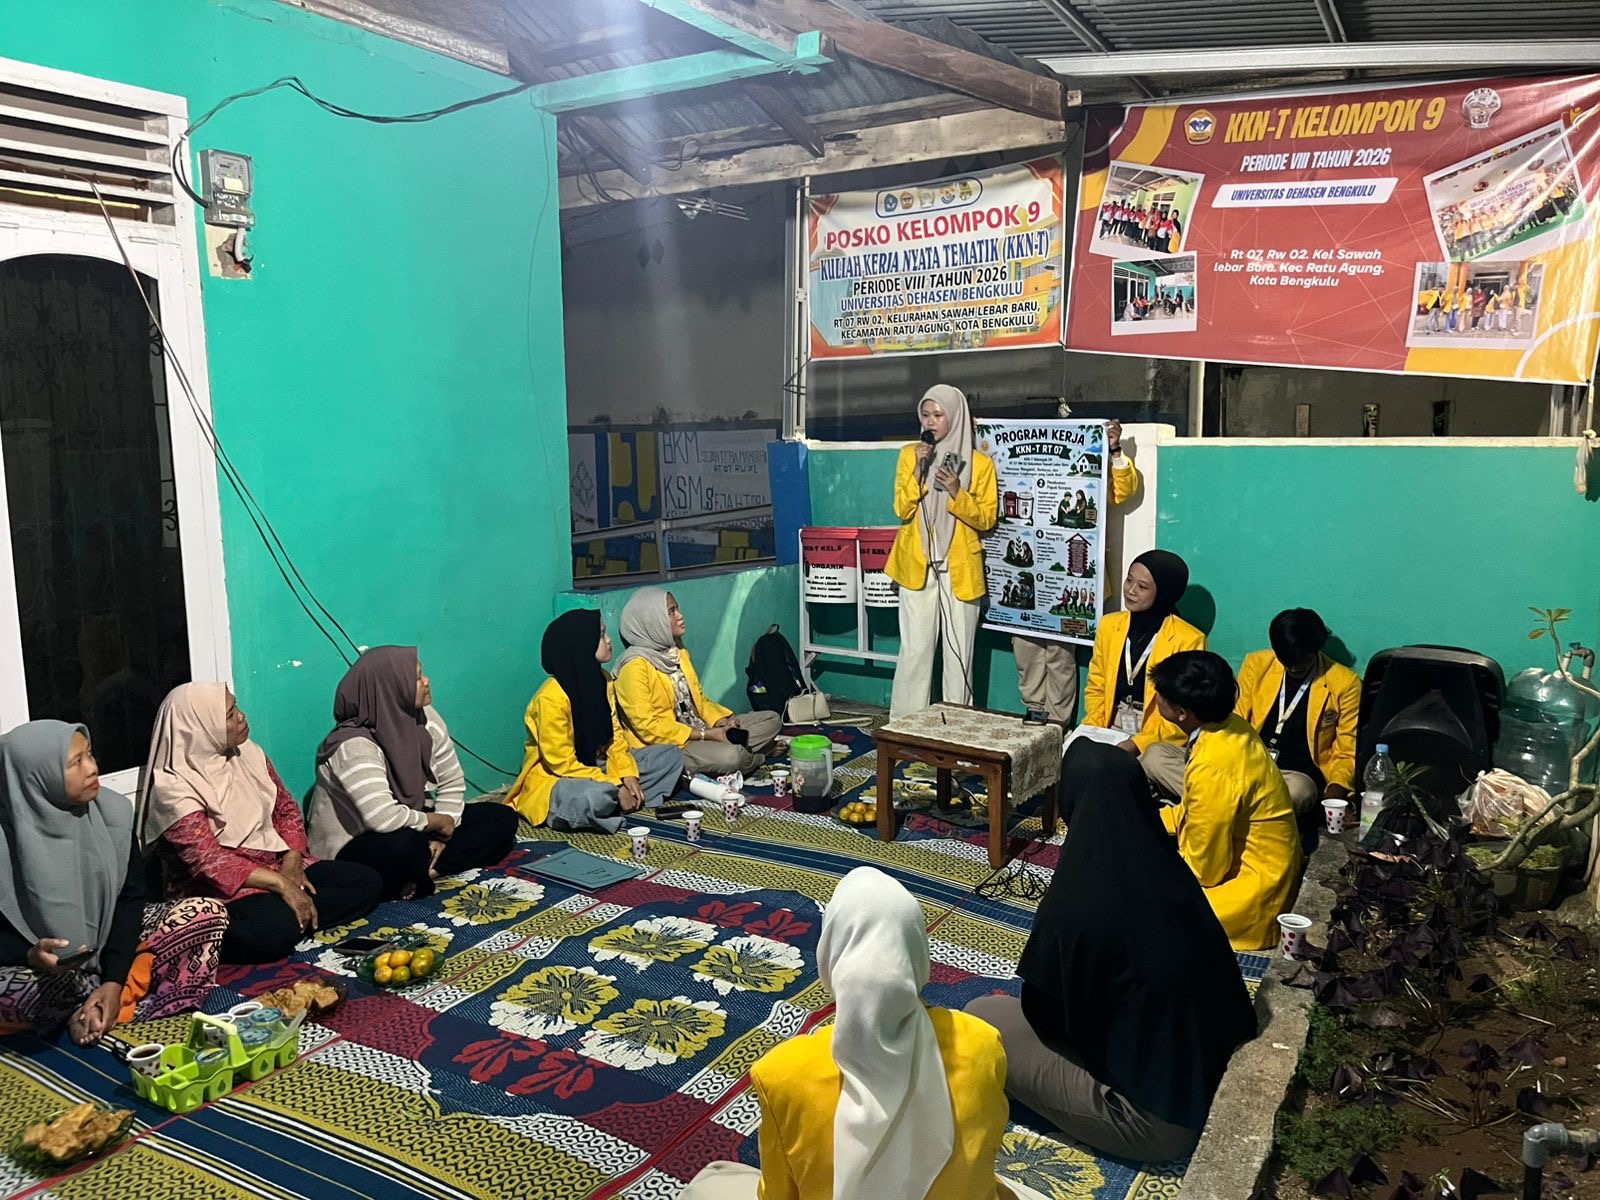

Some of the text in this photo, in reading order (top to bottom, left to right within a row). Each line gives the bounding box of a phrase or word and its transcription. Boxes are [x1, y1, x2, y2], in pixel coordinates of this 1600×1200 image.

[1224, 96, 1447, 144] KKN-T KELOMPOK 9
[1239, 147, 1393, 173] PERIODE VIII TAHUN 2026
[1231, 185, 1376, 201] UNIVERSITAS DEHASEN BENGKULU
[826, 201, 1041, 250] POSKO KELOMPOK 9
[820, 230, 1049, 281] KULIAH KERJA NYATA TEMATIK (KKN-T)
[1230, 249, 1244, 260] Rt
[1266, 249, 1287, 260] Rw
[1289, 249, 1309, 260] 02.
[1312, 249, 1333, 260] Kel
[1336, 249, 1382, 260] Sawah
[853, 266, 1007, 295] PERIODE VIII TAHUN 2026
[1213, 262, 1244, 273] lebar
[1279, 262, 1303, 273] Kec
[1306, 262, 1336, 273] Ratu
[1338, 263, 1385, 276] Agung.
[1249, 275, 1339, 289] Kota Bengkulu
[841, 282, 1023, 311] UNIVERSITAS DEHASEN BENGKULU
[834, 301, 1040, 328] RT 07 RW 02, KELURAHAN SAWAH LEBAR BARU,
[841, 315, 1034, 339] KECAMATAN RATU AGUNG, KOTA BENGKULU
[662, 431, 700, 464] BKM
[994, 428, 1085, 446] PROGRAM KERJA
[1015, 444, 1064, 455] KKN-T RT 07
[663, 475, 702, 510] KSM
